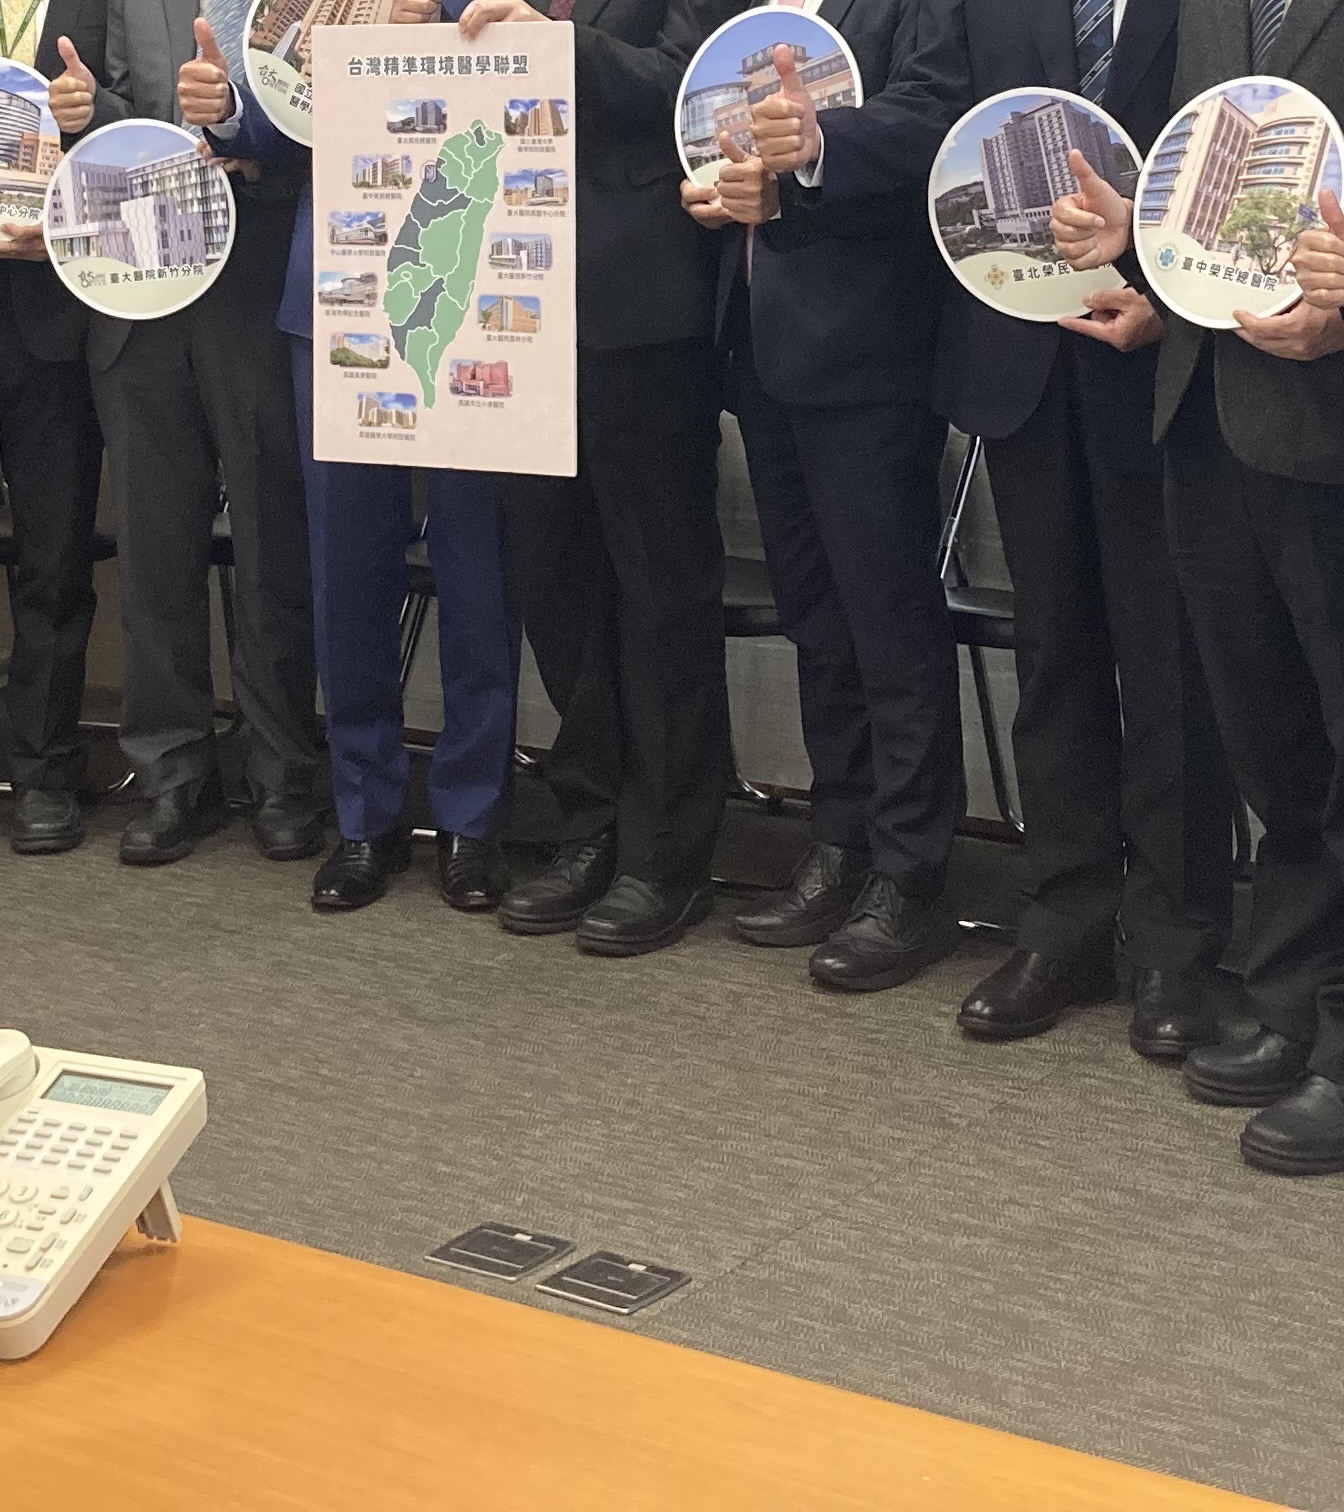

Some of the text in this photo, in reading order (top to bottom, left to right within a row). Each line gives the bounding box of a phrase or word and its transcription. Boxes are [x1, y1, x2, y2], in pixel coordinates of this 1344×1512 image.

[347, 54, 529, 76] 台灣精準環境醫學聯盟
[289, 94, 313, 116] 醫學
[109, 264, 204, 284] 臺大醫院新竹分院
[1181, 256, 1279, 292] 臺中榮民總醫院
